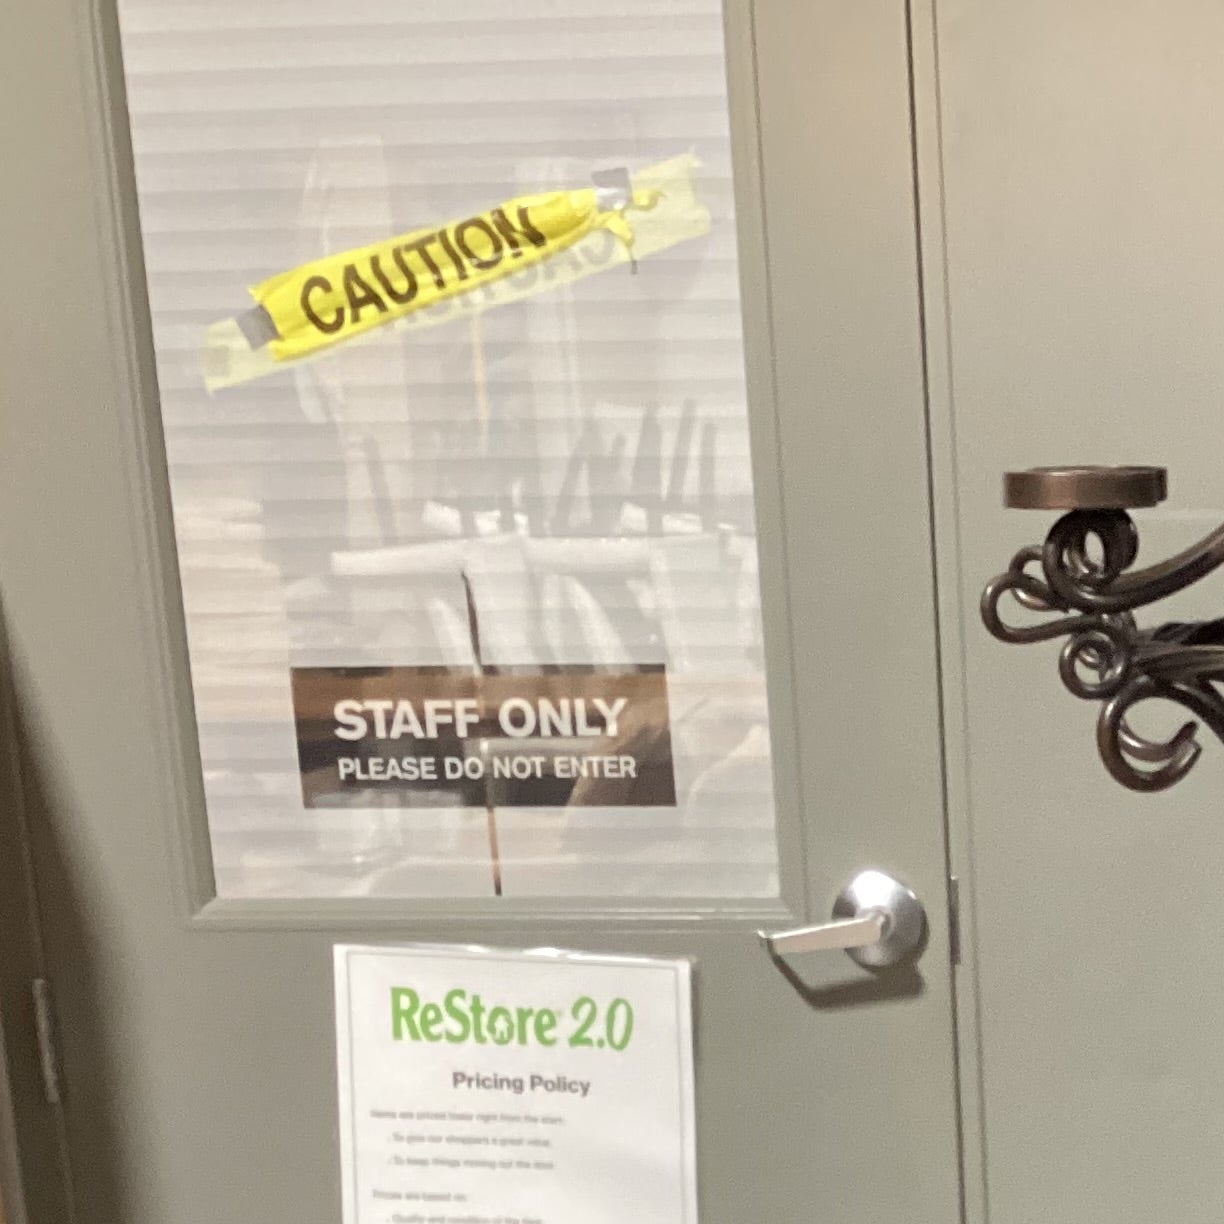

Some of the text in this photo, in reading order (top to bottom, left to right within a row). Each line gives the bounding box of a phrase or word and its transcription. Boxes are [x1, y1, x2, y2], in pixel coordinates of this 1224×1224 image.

[300, 206, 546, 335] CAUTION
[333, 698, 627, 740] STAFF ONLY
[338, 756, 637, 781] PLEASE DO NOT ENTER
[389, 986, 634, 1051] ReStore 2.0
[451, 1071, 591, 1097] Pricing Policy
